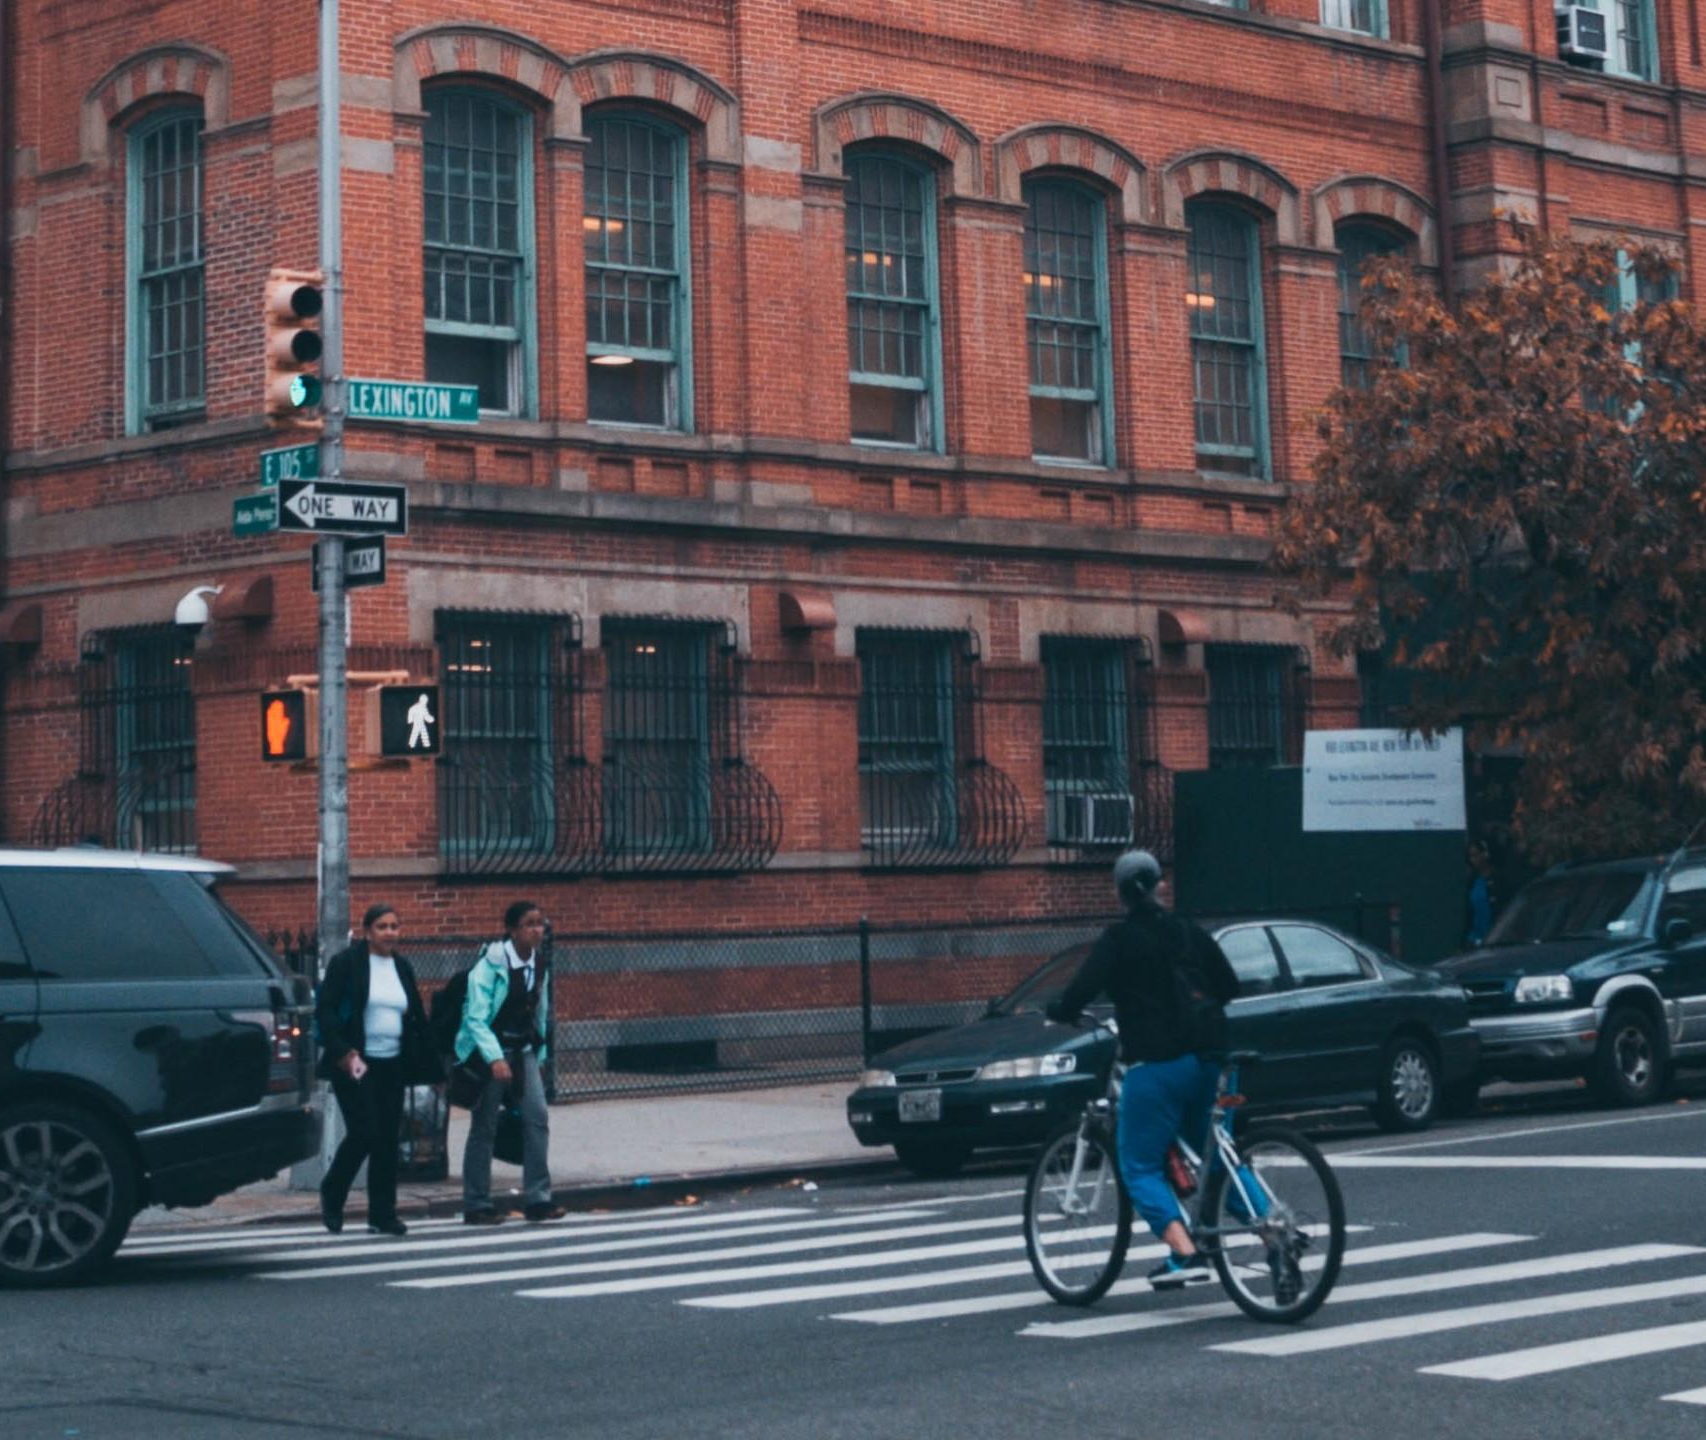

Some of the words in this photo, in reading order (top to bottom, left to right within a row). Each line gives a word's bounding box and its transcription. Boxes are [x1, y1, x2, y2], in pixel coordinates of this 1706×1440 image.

[349, 384, 450, 417] LEXINGTON
[266, 455, 273, 484] E
[298, 496, 335, 516] ONE
[352, 499, 389, 518] WAY
[352, 551, 376, 573] WAY
